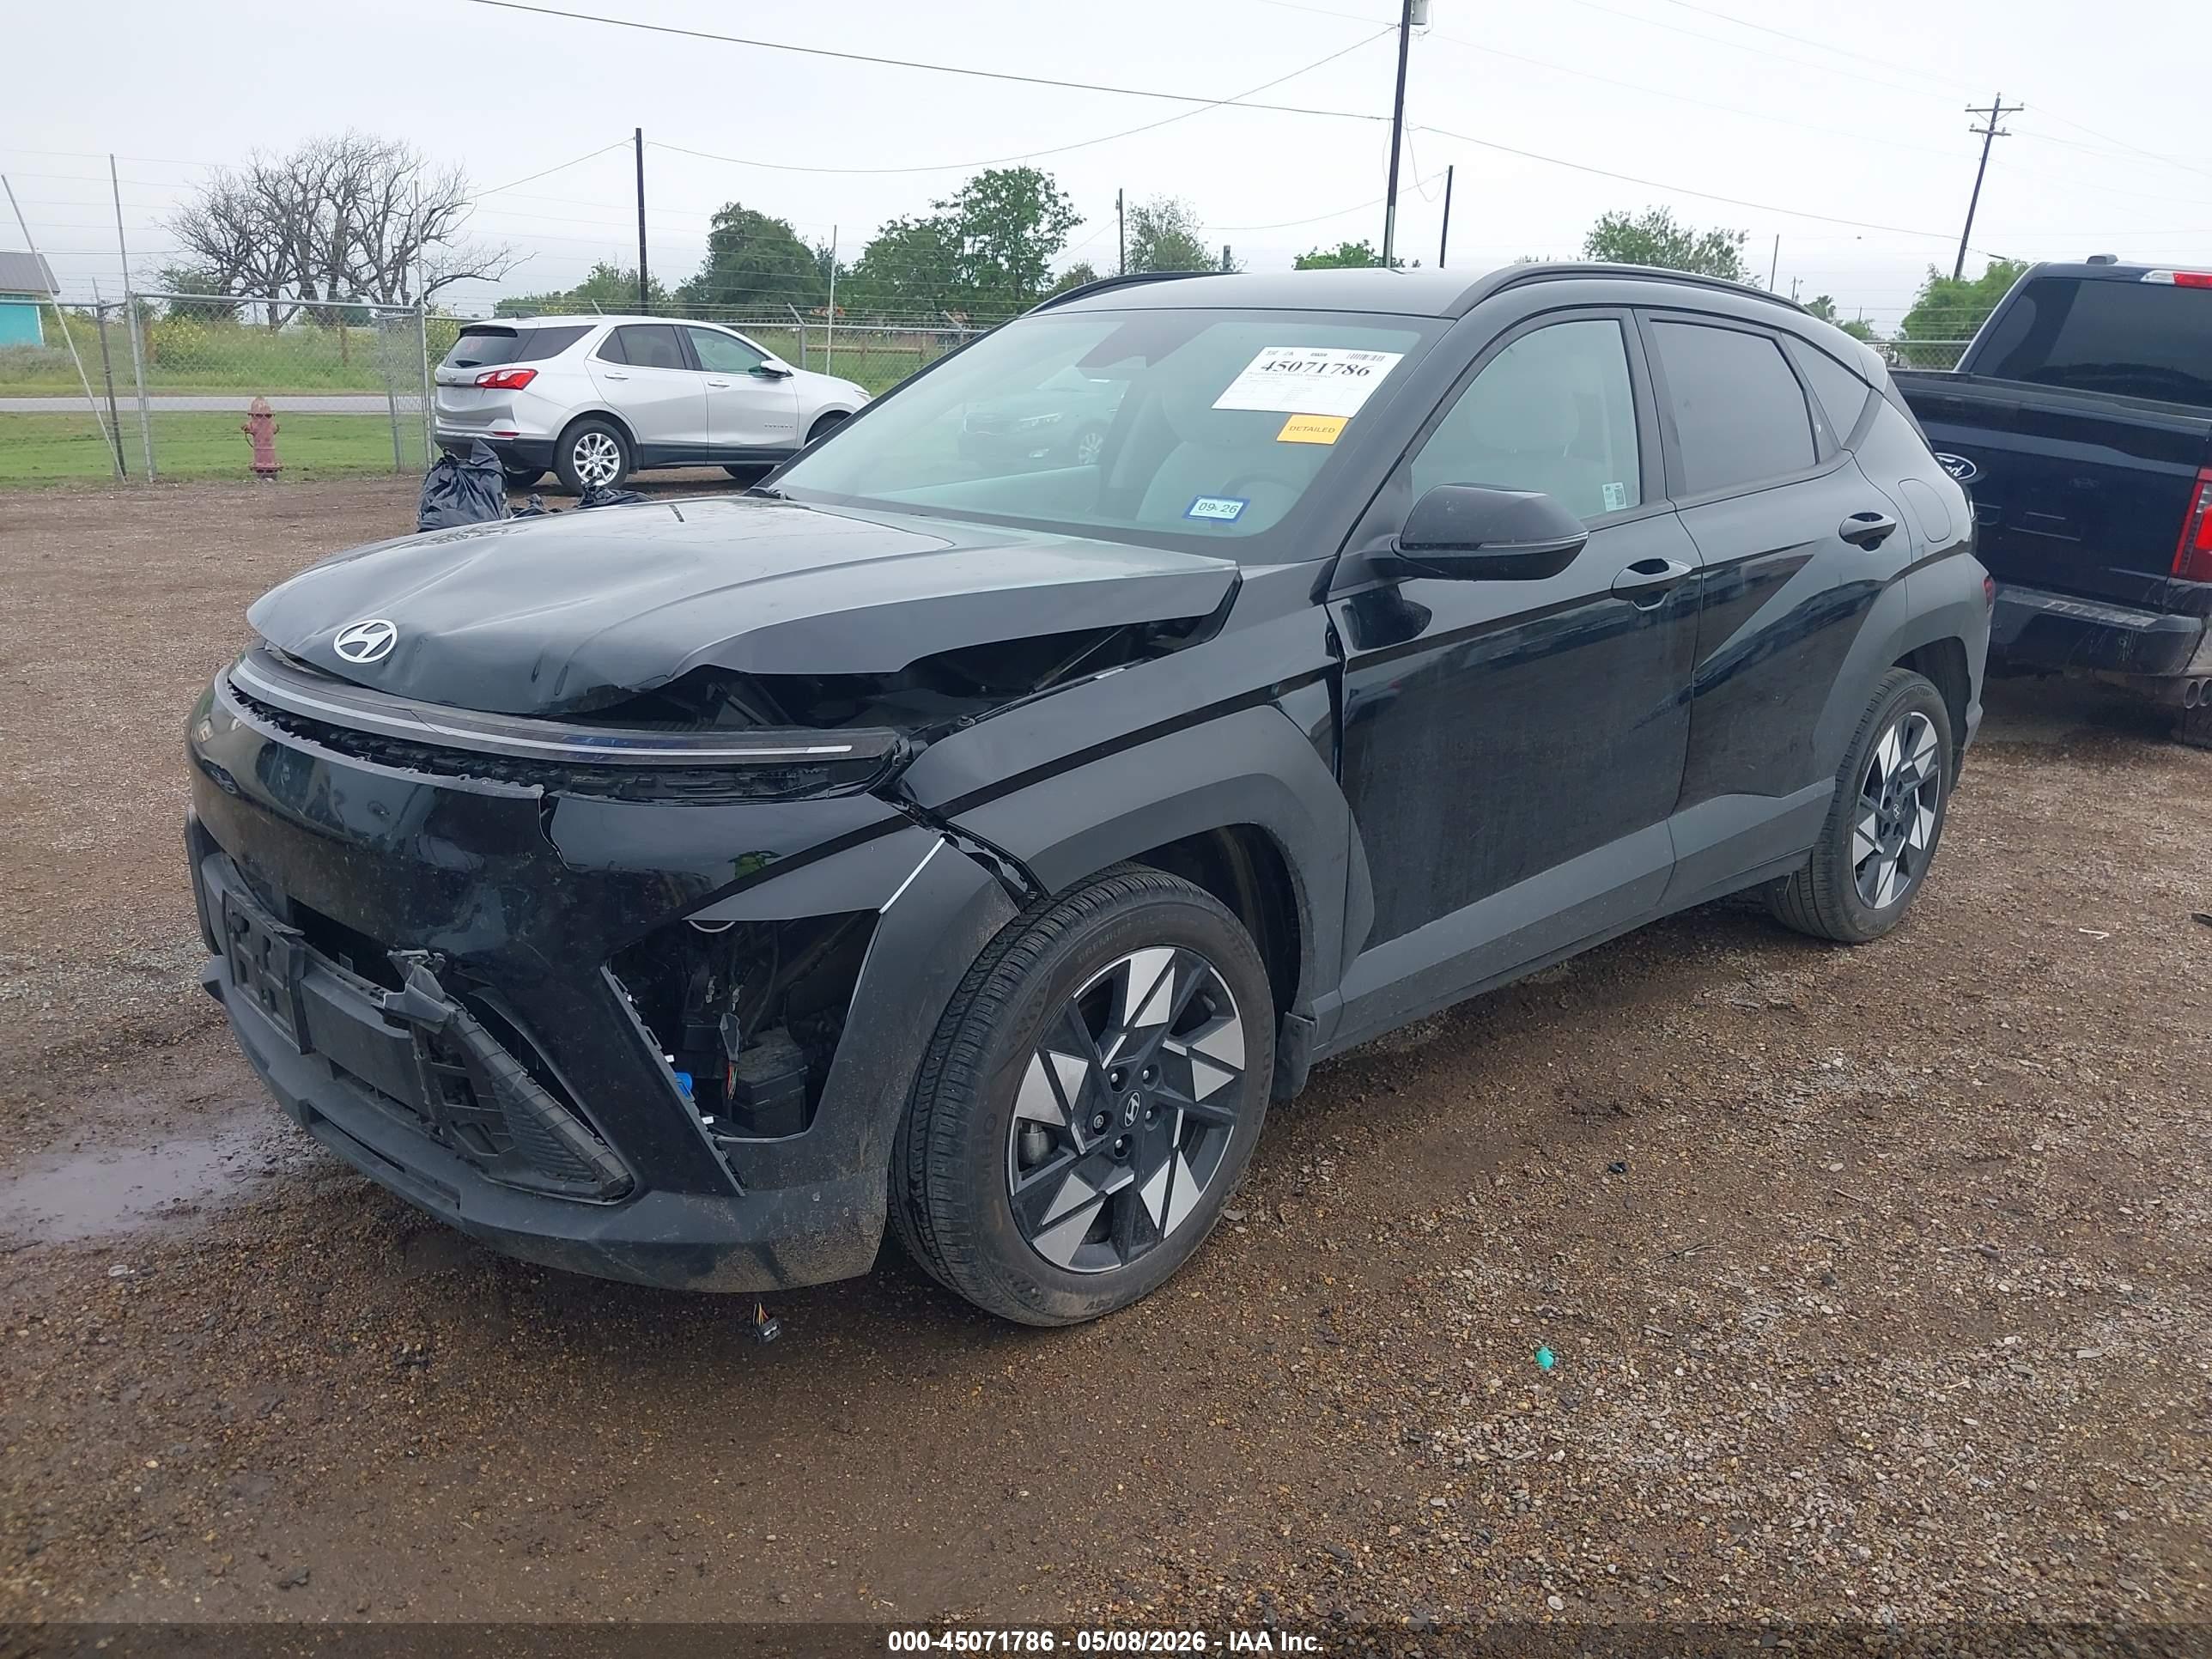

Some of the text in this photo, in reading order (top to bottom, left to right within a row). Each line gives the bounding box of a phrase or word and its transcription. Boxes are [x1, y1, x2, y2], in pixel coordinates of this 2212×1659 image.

[1261, 361, 1373, 377] 45071786
[1289, 424, 1336, 434] DETAILED
[1198, 502, 1239, 514] 09 26
